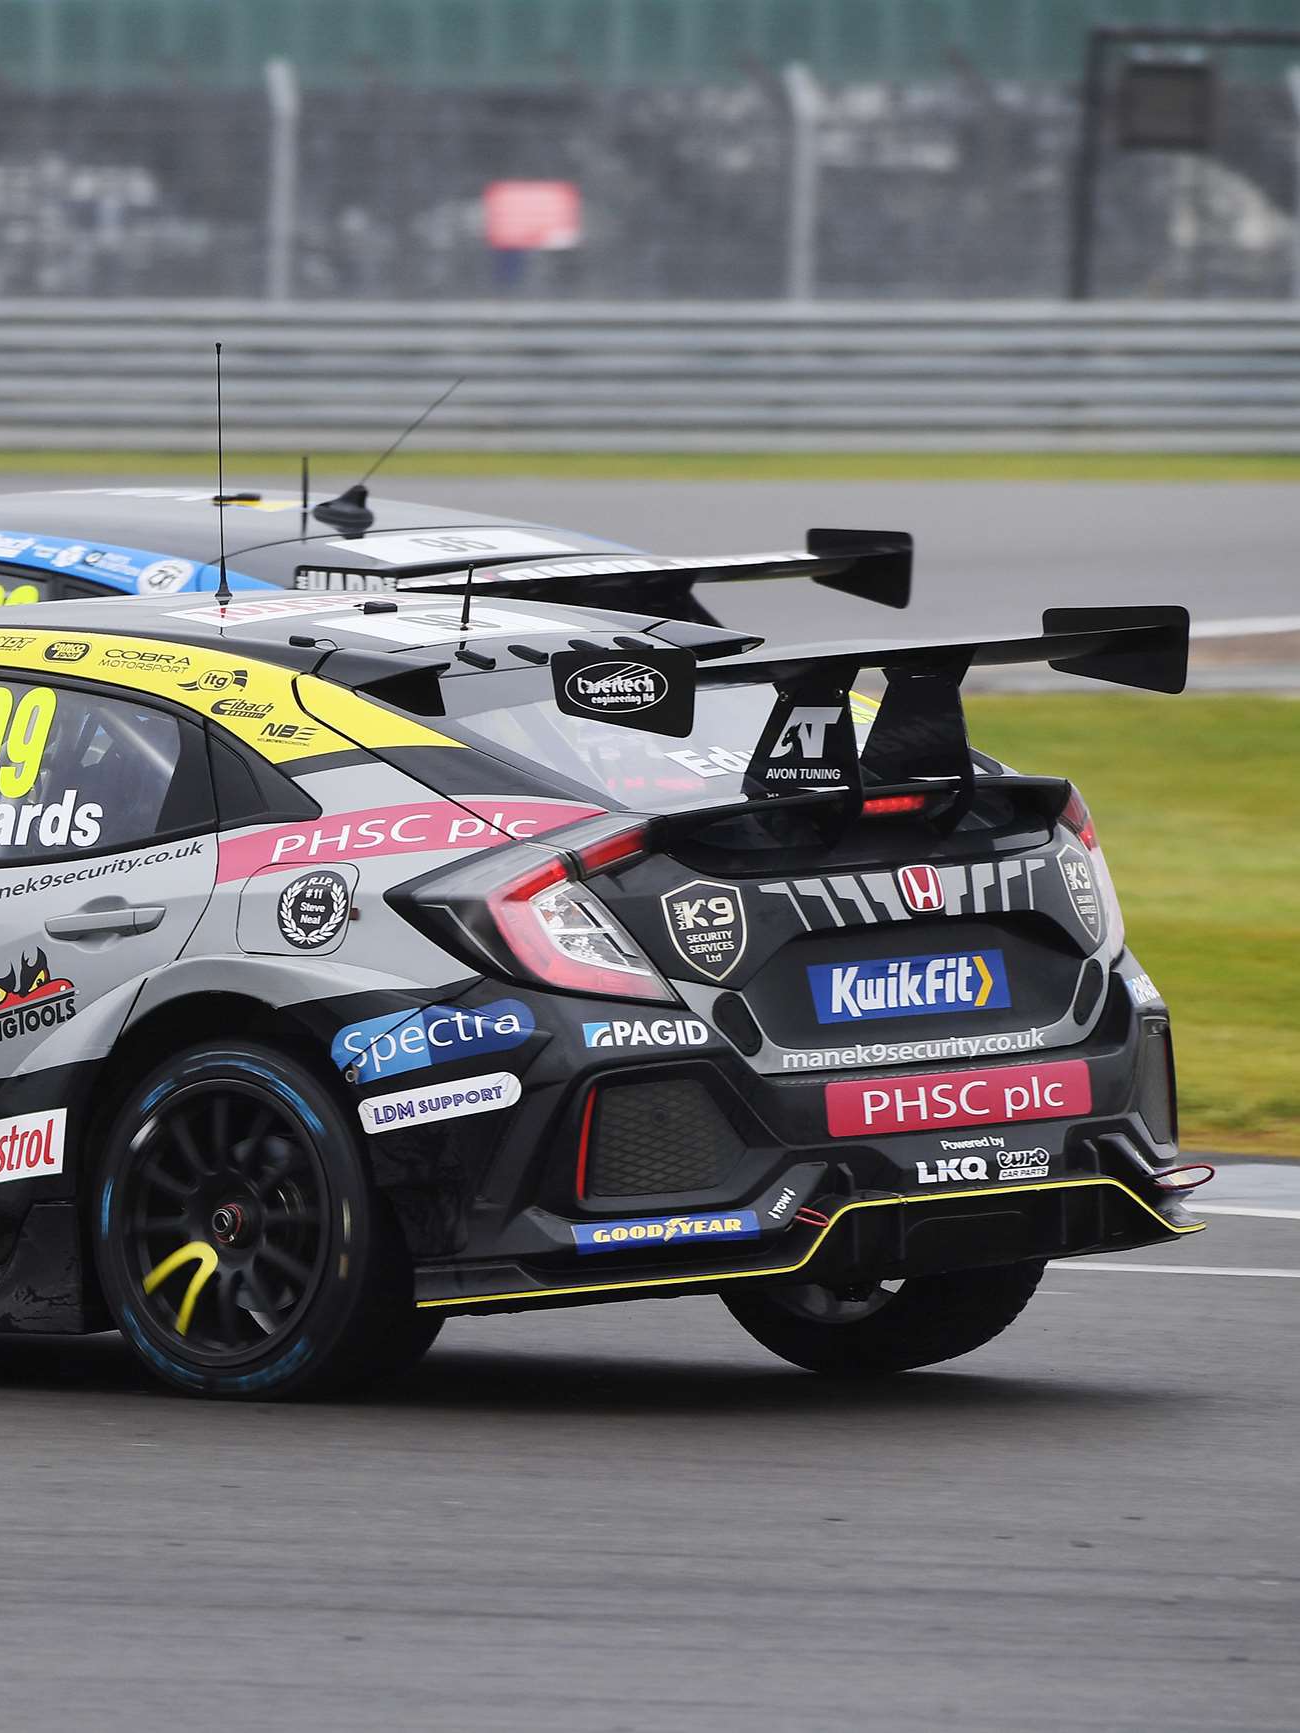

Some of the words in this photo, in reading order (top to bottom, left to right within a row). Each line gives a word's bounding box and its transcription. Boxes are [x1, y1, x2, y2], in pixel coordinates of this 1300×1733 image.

[104, 649, 191, 666] COBRA
[98, 659, 189, 674] MOTORSPORT
[204, 673, 228, 688] itg
[591, 693, 642, 706] engineering
[211, 698, 274, 717] Eibach
[765, 768, 798, 781] AVON
[799, 768, 841, 781] TUNING
[271, 813, 432, 864] PHSC
[448, 812, 539, 844] plc
[305, 888, 324, 899] #11
[300, 902, 326, 912] Steve
[682, 896, 735, 930] K9
[300, 914, 321, 924] Neal
[686, 930, 732, 944] SECURITY
[689, 941, 735, 955] SERVICES
[706, 953, 722, 963] Ltd
[611, 1020, 709, 1047] PAGID
[343, 1010, 521, 1073] Spectra
[782, 1028, 1046, 1072] manek9security.co.uk
[373, 1096, 415, 1125] LDM
[418, 1085, 503, 1115] SUPPORT
[862, 1080, 990, 1125] PHSC
[1004, 1076, 1065, 1119] plc
[940, 1137, 989, 1151] Powered
[990, 1136, 1004, 1148] by
[915, 1155, 989, 1184] LKQ
[1001, 1169, 1019, 1179] CAR
[1020, 1167, 1047, 1178] PARTS
[772, 1192, 793, 1214] TOW
